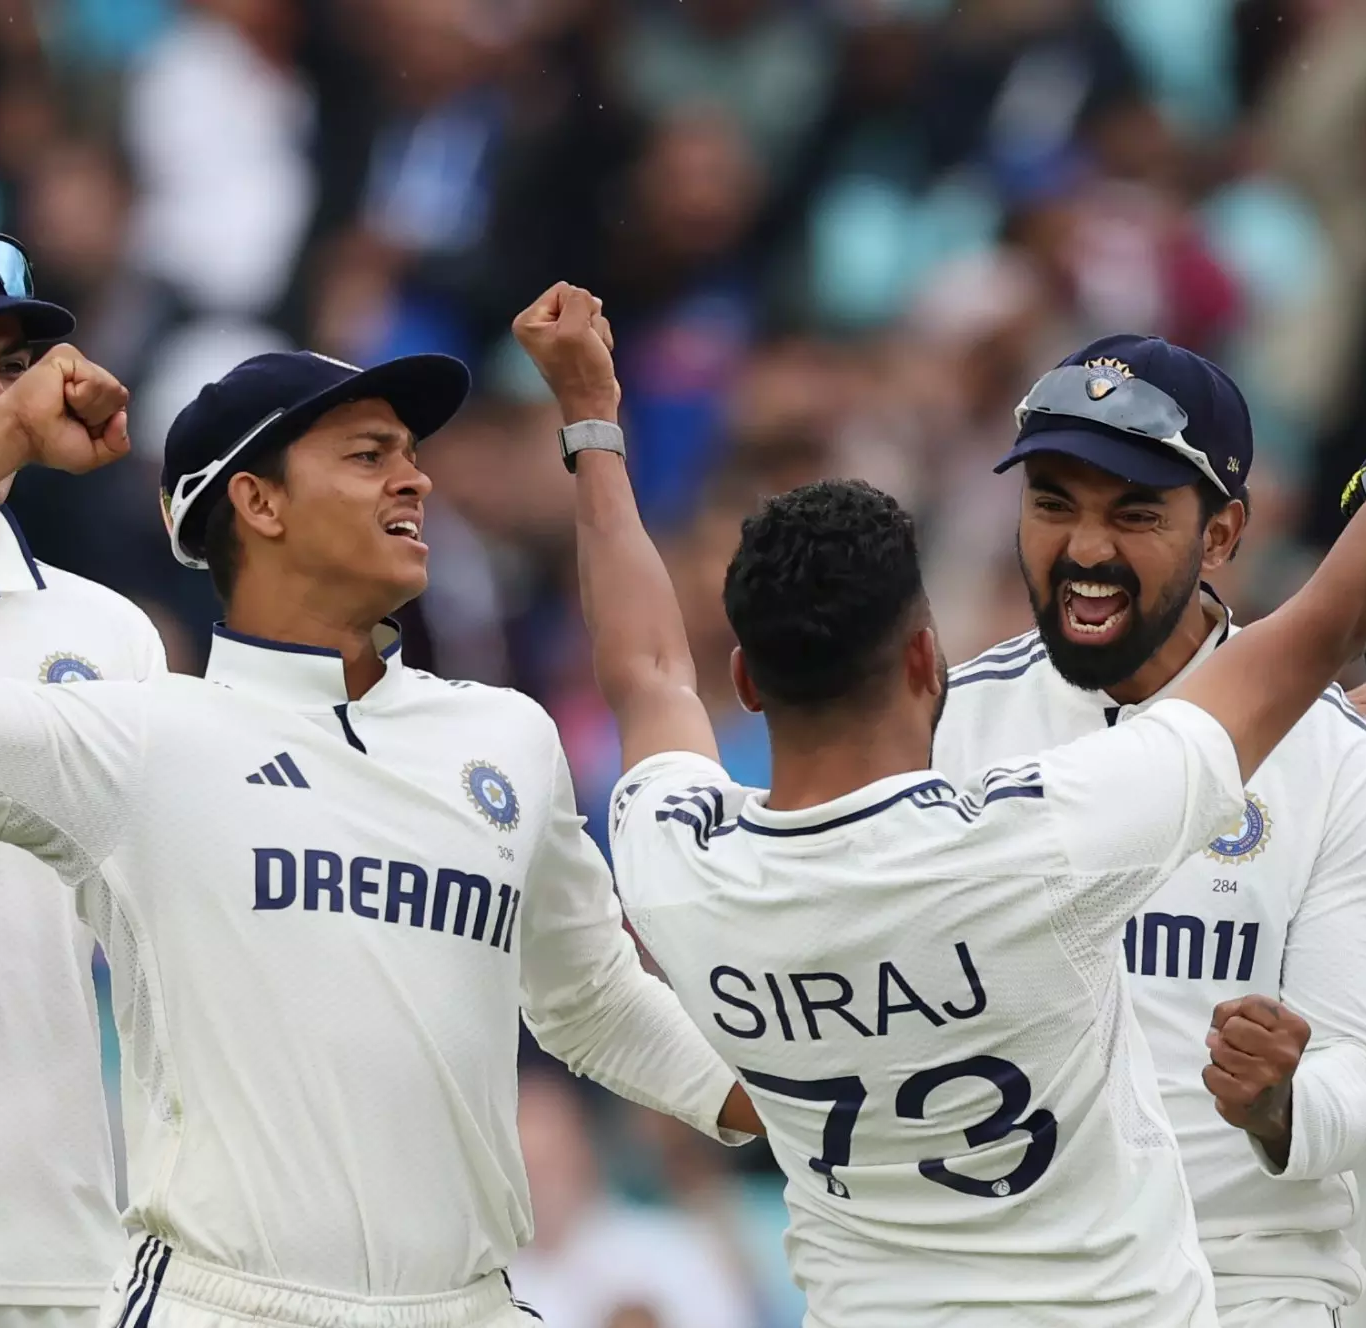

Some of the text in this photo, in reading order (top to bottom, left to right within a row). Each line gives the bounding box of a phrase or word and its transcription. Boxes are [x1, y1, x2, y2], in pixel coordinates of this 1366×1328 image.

[497, 845, 515, 862] 306
[1212, 878, 1238, 894] 284
[252, 848, 521, 954] DREAM11
[1122, 912, 1260, 981] M11
[710, 941, 987, 1042] SIRAJ
[736, 1054, 1059, 1200] 73
